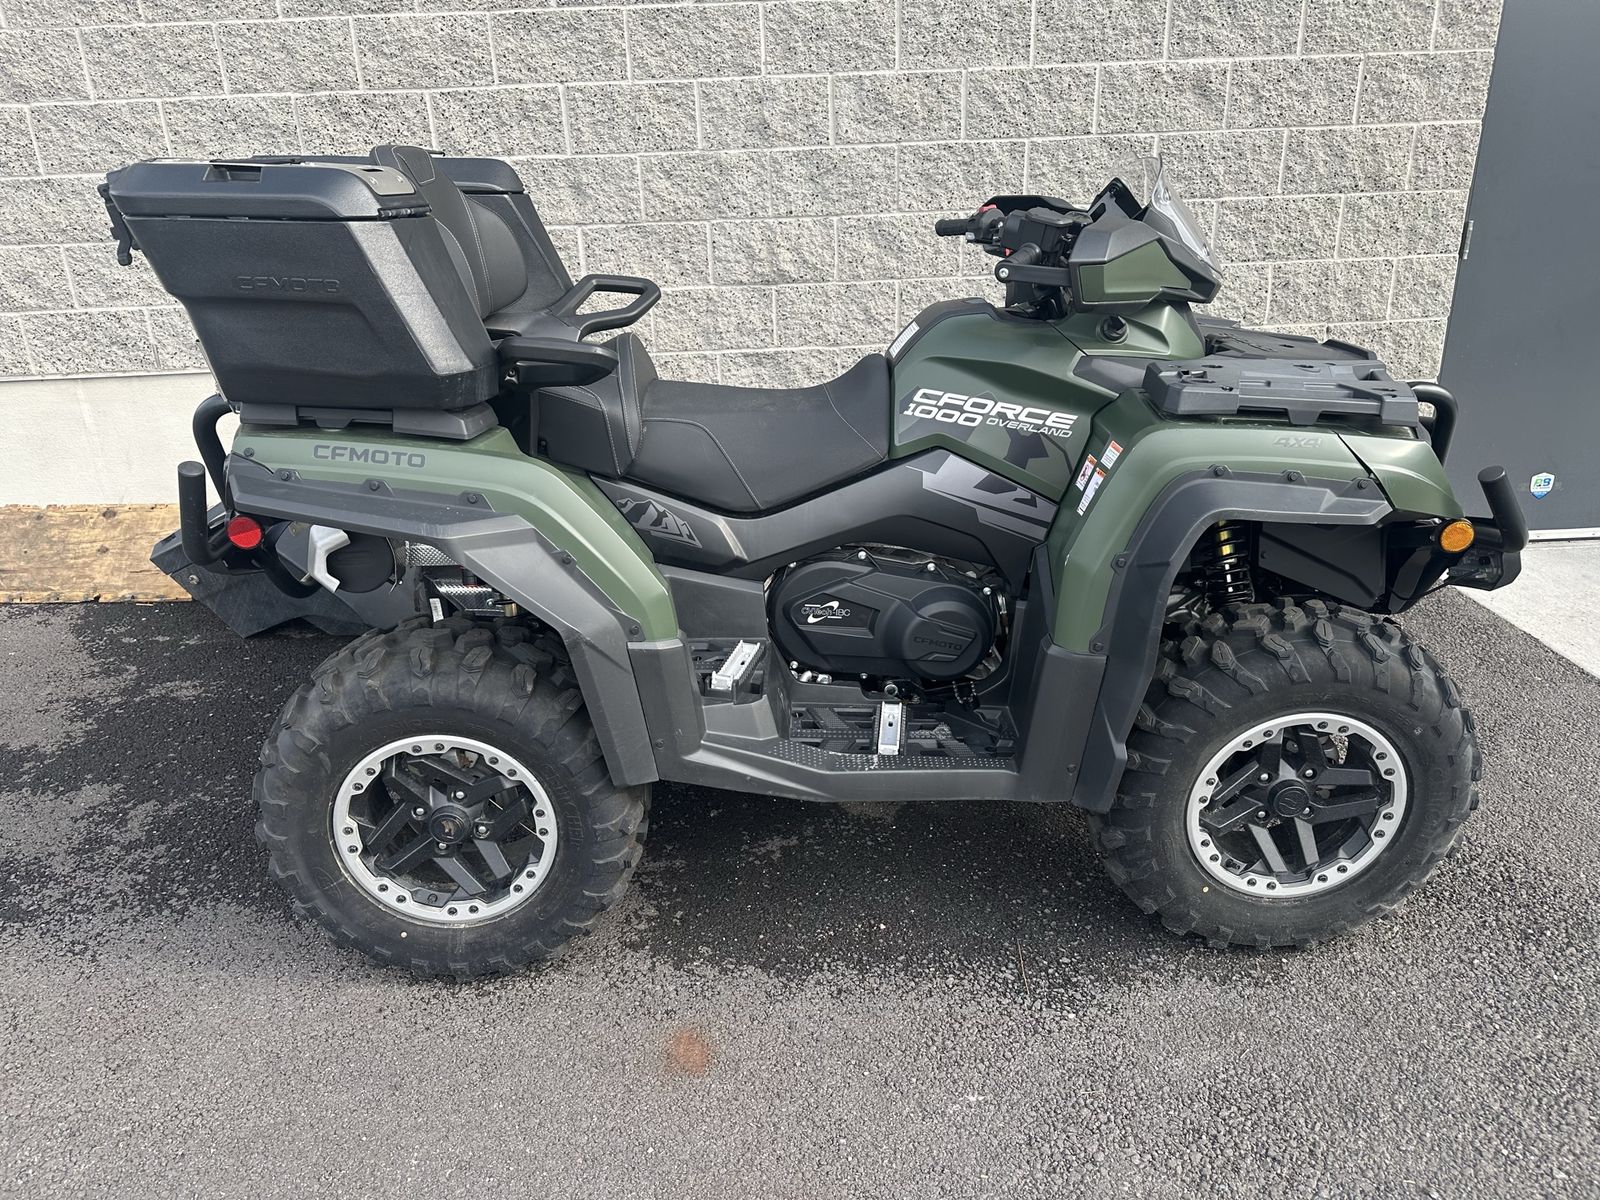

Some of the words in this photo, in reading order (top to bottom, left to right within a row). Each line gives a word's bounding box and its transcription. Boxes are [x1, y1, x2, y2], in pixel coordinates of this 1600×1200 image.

[903, 402, 983, 427] 1000
[986, 417, 1073, 439] OVERLAND
[912, 387, 1079, 430] CFORCE
[313, 444, 426, 468] CFMOTO
[913, 636, 963, 651] CFMOTO
